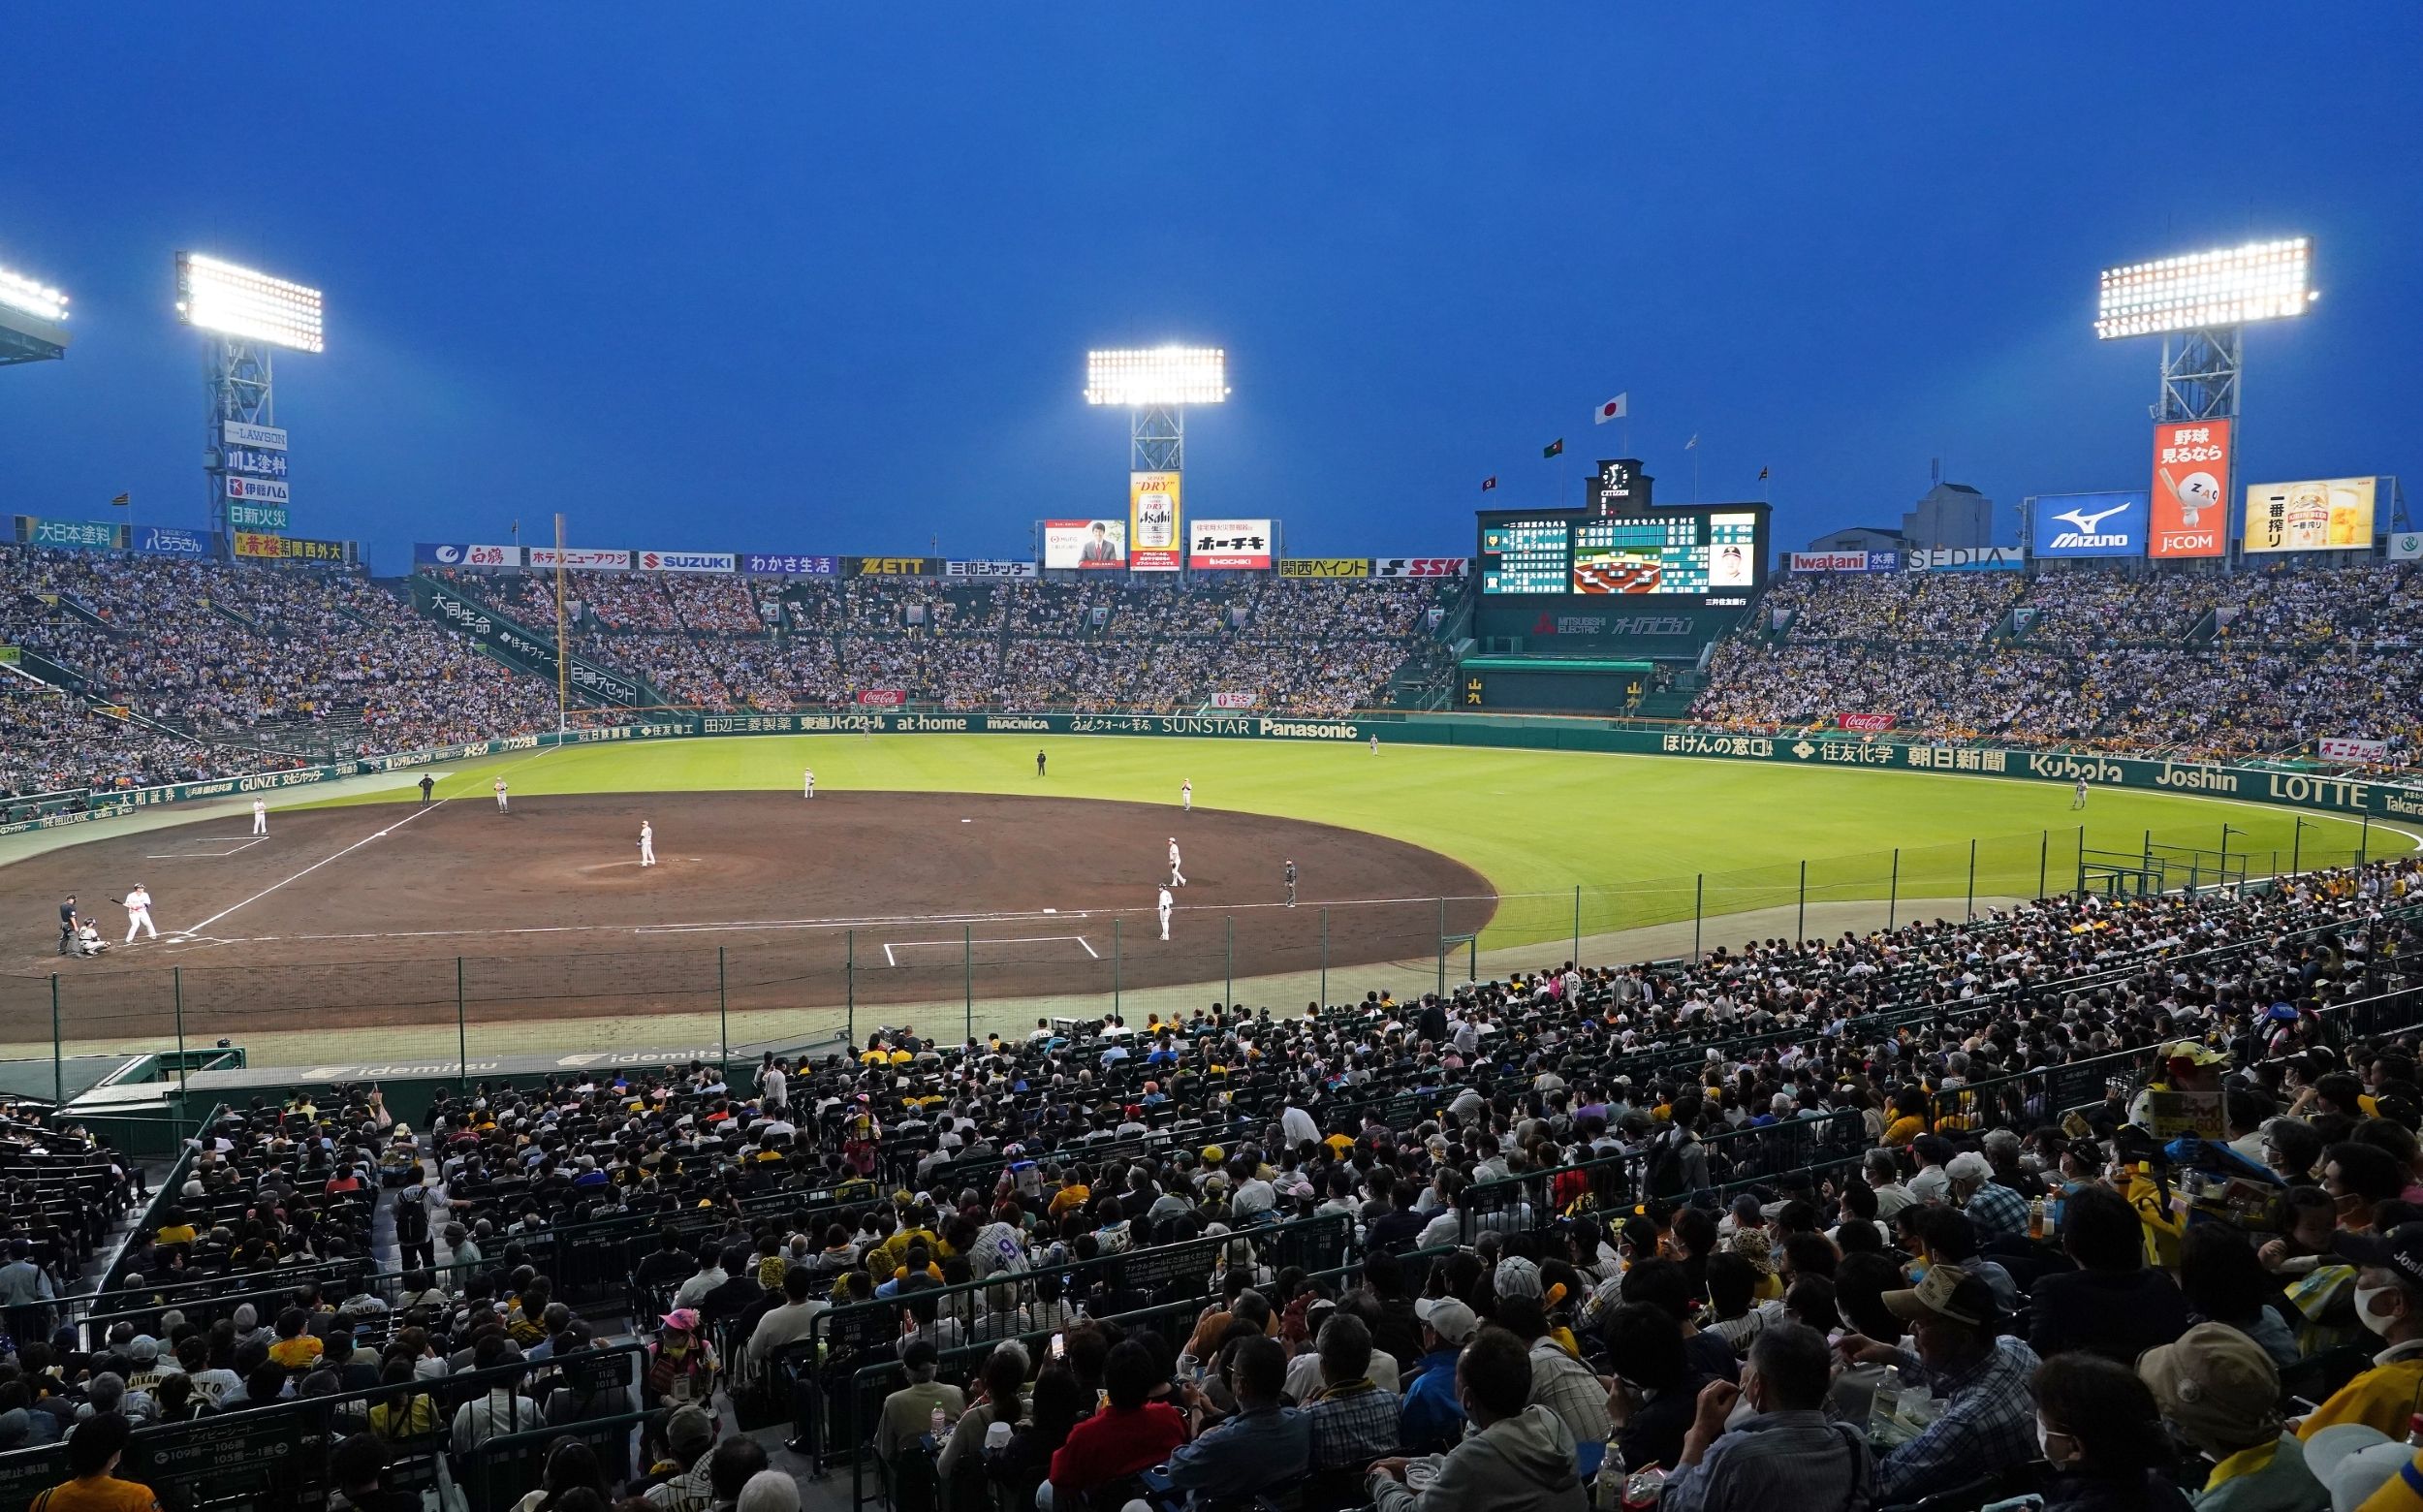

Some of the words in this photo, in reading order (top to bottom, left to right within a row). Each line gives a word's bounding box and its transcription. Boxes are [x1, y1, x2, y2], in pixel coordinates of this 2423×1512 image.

[240, 428, 286, 445] LAWSON
[2174, 428, 2209, 445] 野球
[2161, 445, 2222, 464] 見るなら
[229, 451, 286, 476] 川上塗料
[245, 483, 286, 498] 伊藤ハム
[231, 506, 286, 526] 日新火災
[1140, 511, 1170, 523] Asahi
[2269, 496, 2285, 547] 一番搾り
[38, 522, 111, 545] 大日本塗料
[161, 536, 202, 552] ろうきん
[246, 535, 280, 555] 黄桜
[293, 541, 341, 559] 関西外大
[1197, 537, 1264, 550] ホーチキ
[2161, 535, 2212, 552] J:COM
[471, 547, 504, 565] 白鶴
[533, 551, 627, 567] ホテルニューアワジ
[664, 556, 731, 569] SUZUKI
[751, 556, 830, 573] わかさ生活
[1794, 553, 1863, 569] Iwatani
[1871, 553, 1895, 564] 水素
[1909, 548, 2005, 568] SEDIA
[860, 558, 923, 575] ZETT
[1281, 561, 1366, 576] 関西ペイント
[1408, 559, 1464, 575] SSK
[432, 593, 491, 634] 大同生命
[1558, 617, 1605, 626] MITSUBISHI
[573, 667, 634, 702] 日興アセット
[1468, 678, 1481, 704] 山九
[653, 725, 693, 735] 住友電工
[705, 717, 791, 733] 田辺三菱製薬
[801, 716, 885, 730] 東進ハイスクール
[897, 718, 914, 730] at
[919, 715, 966, 730] home
[1163, 718, 1249, 734] SUNSTAR
[1261, 718, 1357, 739] Panasonic
[592, 728, 631, 740] 日鉄鋼板
[508, 736, 537, 750] フコク生命
[1663, 734, 1766, 757] ほけんの窓口
[1821, 743, 1893, 764] 住友化学
[1908, 747, 2006, 772] 朝日新聞
[2321, 742, 2385, 762] 不二サッシ
[2030, 754, 2122, 782] Kubota
[2156, 757, 2237, 792] Joshin
[240, 775, 279, 791] GUNZE
[2270, 775, 2368, 808] LOTTE
[120, 788, 175, 806] 大和証券
[2385, 795, 2423, 816] Takara
[611, 1050, 739, 1063] idemitsu
[358, 1063, 497, 1076] idemitsu
[2196, 1118, 2223, 1132] 600
[999, 1239, 1017, 1259] 9
